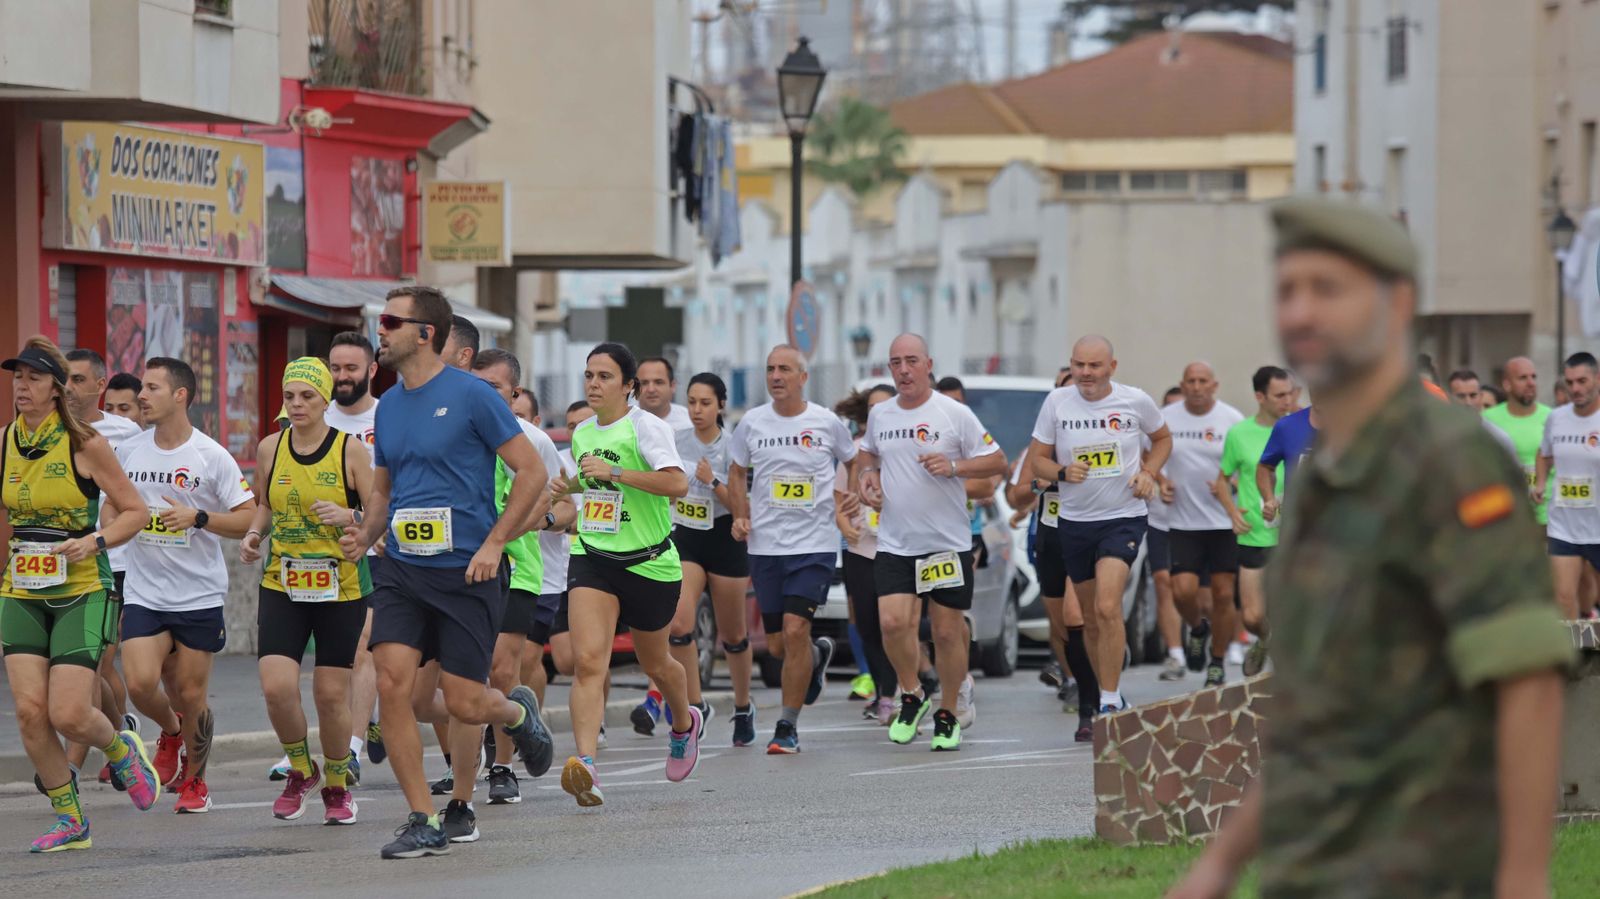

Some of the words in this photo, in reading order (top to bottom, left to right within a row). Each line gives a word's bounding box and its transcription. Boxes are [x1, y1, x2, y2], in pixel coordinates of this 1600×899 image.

[111, 135, 141, 176] DOS
[142, 141, 219, 186] CORAZONES
[111, 194, 216, 248] MINIMARKET
[781, 484, 804, 497] 73
[1561, 485, 1589, 497] 346
[584, 502, 614, 520] 172
[677, 501, 707, 518] 393
[405, 523, 434, 540] 69
[16, 556, 57, 574] 249
[921, 562, 955, 581] 210
[286, 570, 330, 588] 219
